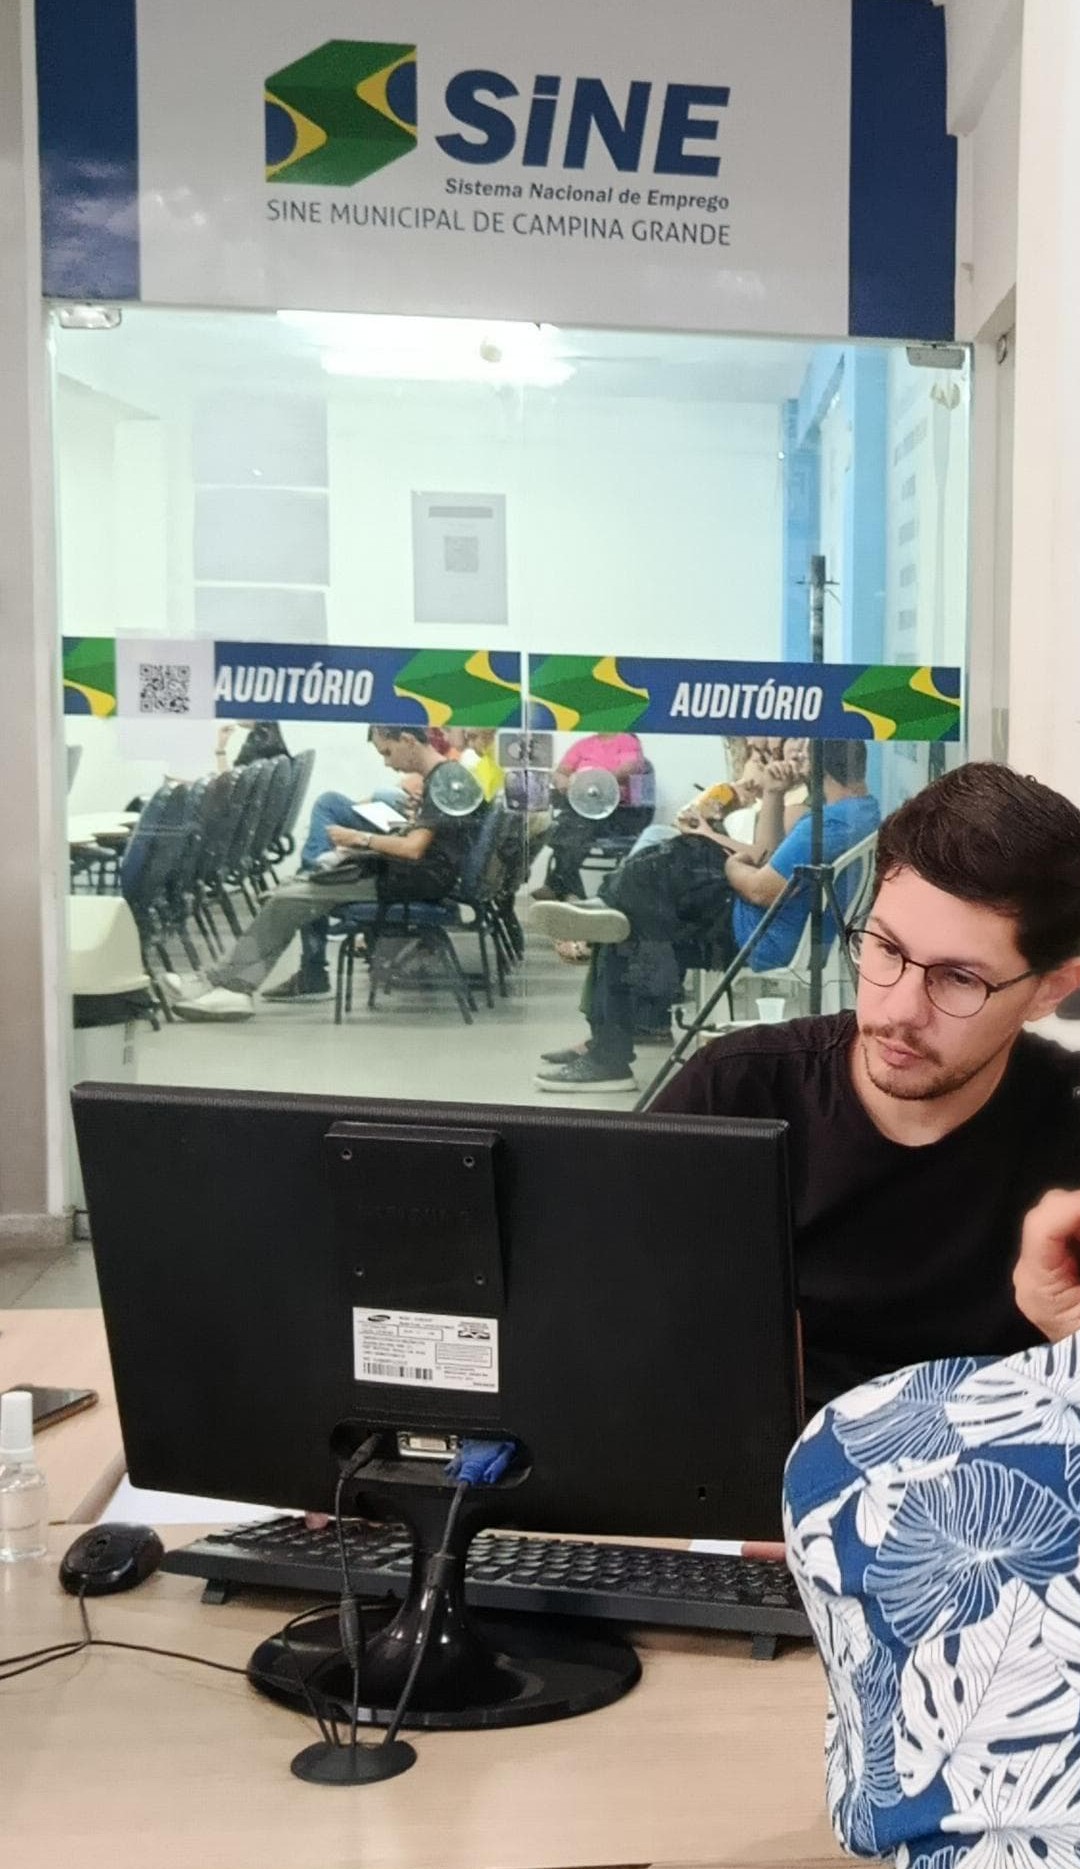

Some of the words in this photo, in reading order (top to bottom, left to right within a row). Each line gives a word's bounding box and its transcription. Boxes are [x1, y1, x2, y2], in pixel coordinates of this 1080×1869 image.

[445, 178, 522, 199] Sistema
[530, 182, 613, 203] Nacional
[619, 188, 641, 206] de
[647, 190, 729, 212] Emprego
[266, 200, 322, 224] SINE
[331, 203, 464, 232] MUNICIPAL
[473, 211, 505, 233] DE
[513, 213, 624, 241] CAMPINA
[632, 220, 731, 246] GRANDE
[214, 662, 374, 706] AUDITÓRIO
[670, 678, 823, 722] AUDITÓRIO
